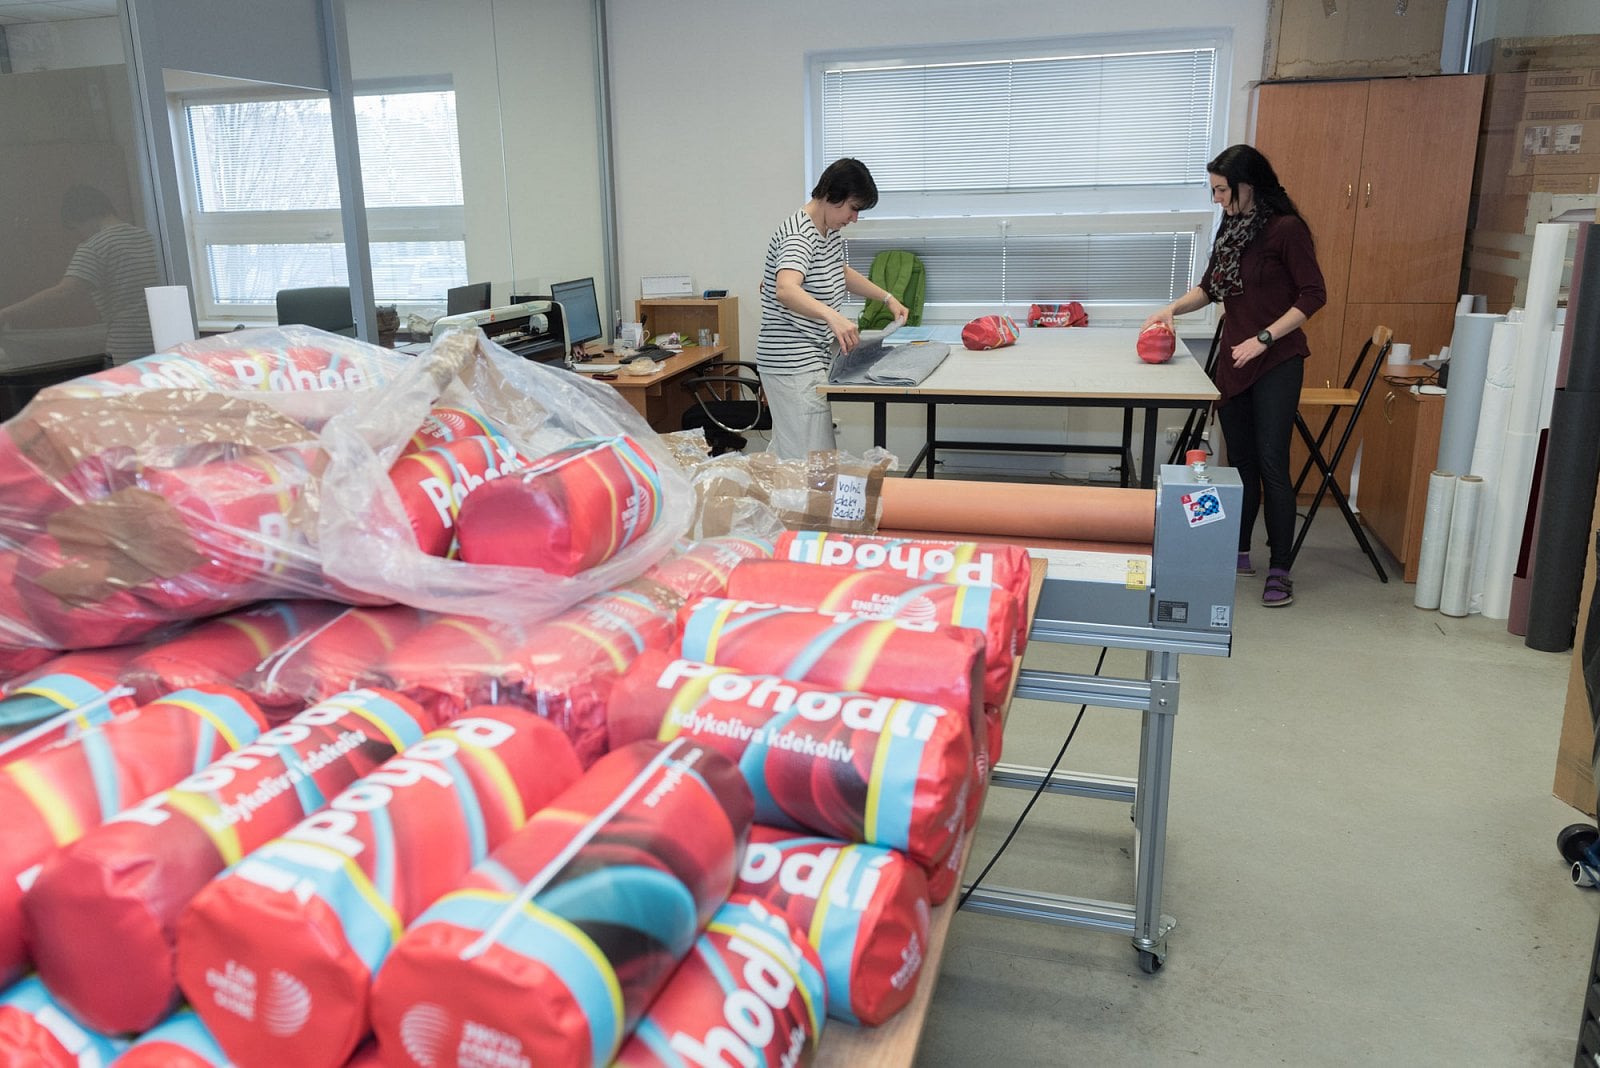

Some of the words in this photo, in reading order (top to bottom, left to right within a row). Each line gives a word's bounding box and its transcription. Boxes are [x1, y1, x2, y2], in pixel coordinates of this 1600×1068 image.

[656, 658, 948, 741] Pohodlí
[671, 707, 752, 741] kdykoliv
[751, 729, 765, 744] a
[767, 729, 855, 762] kdekoliv
[740, 843, 894, 911] odlí
[670, 899, 803, 1068] hodlí
